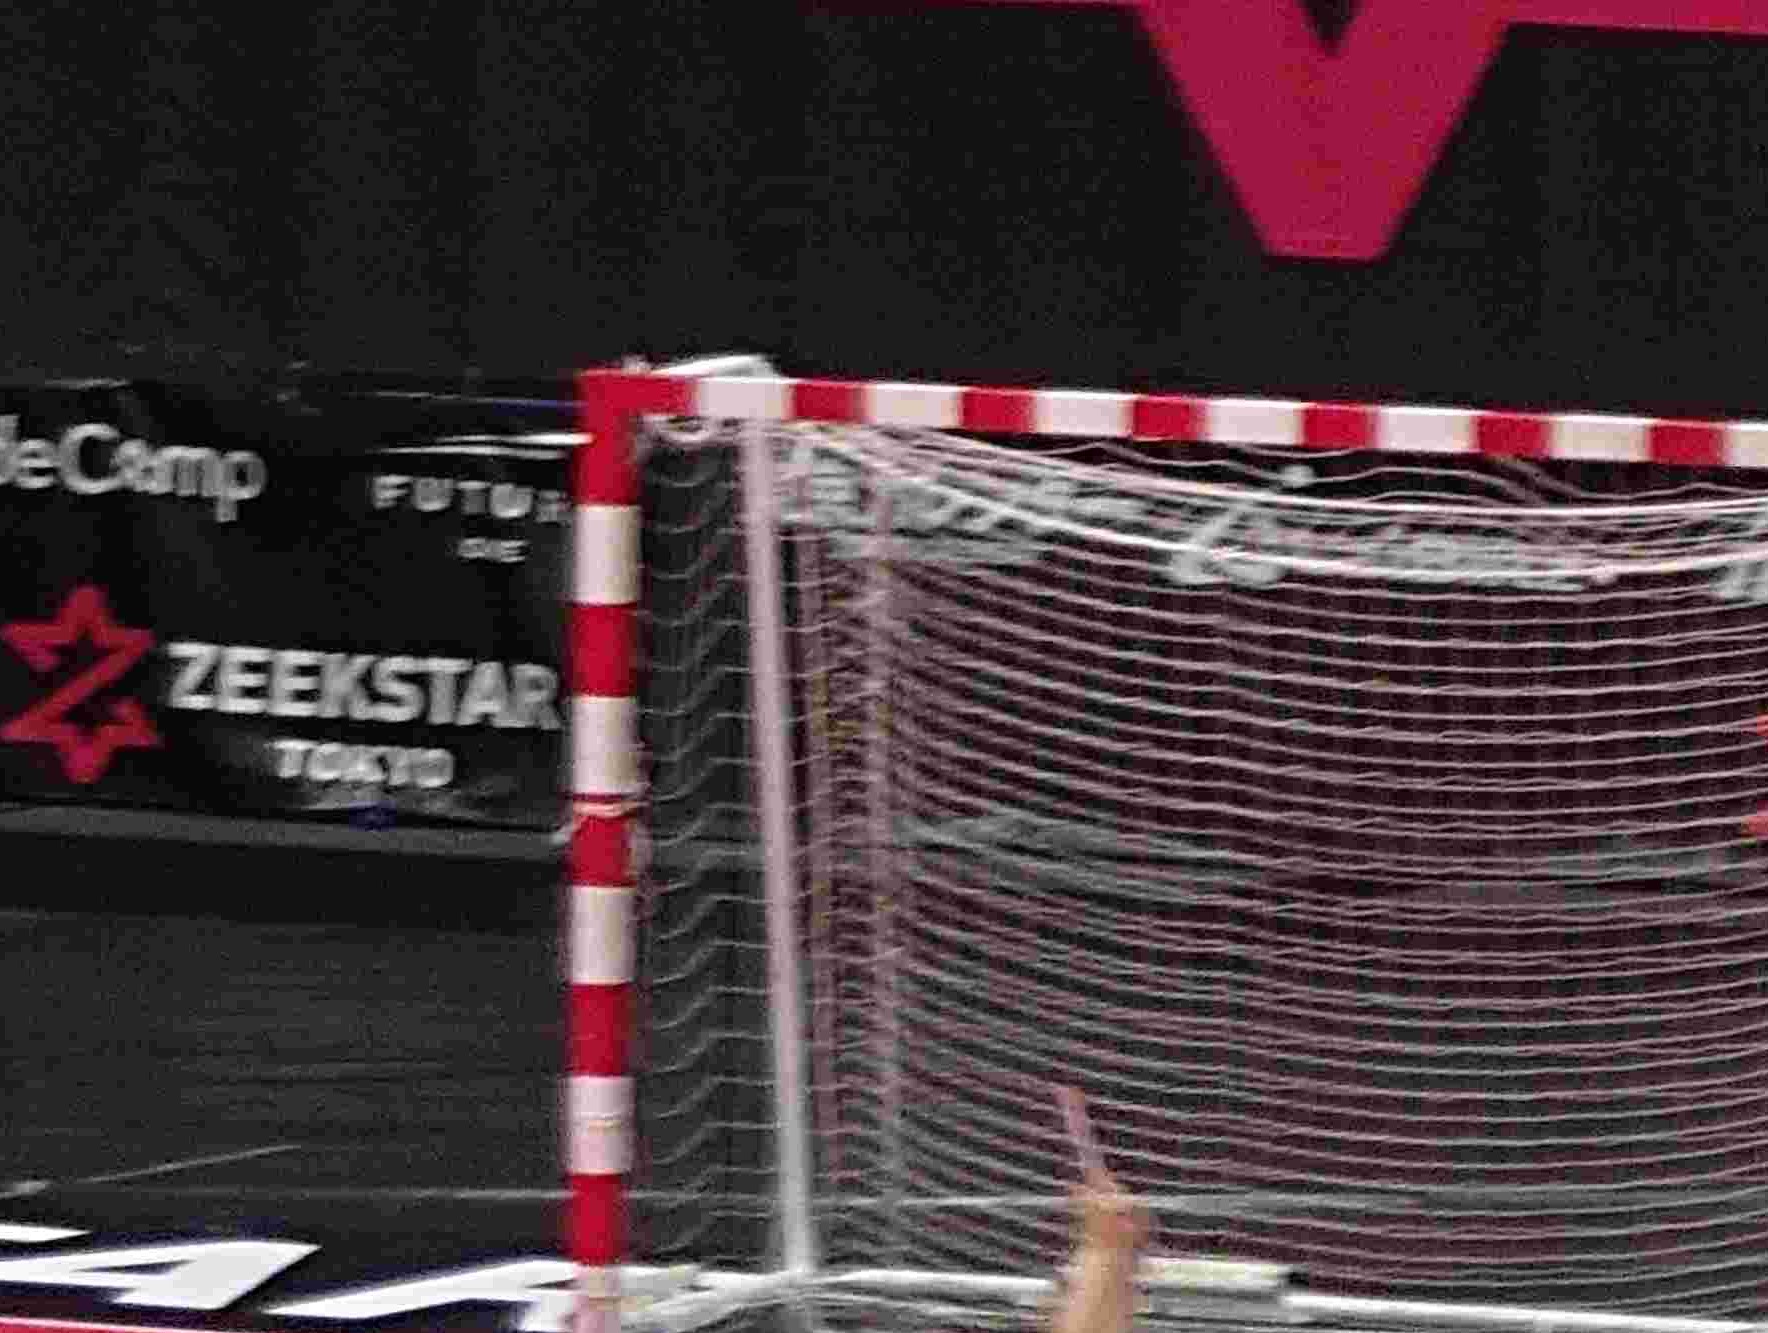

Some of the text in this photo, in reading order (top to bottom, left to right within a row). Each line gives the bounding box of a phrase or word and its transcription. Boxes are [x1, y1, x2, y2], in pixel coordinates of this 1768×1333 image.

[373, 475, 571, 524] FUTUR
[166, 641, 562, 729] ZEEKSTAR
[270, 738, 455, 788] TOKYO
